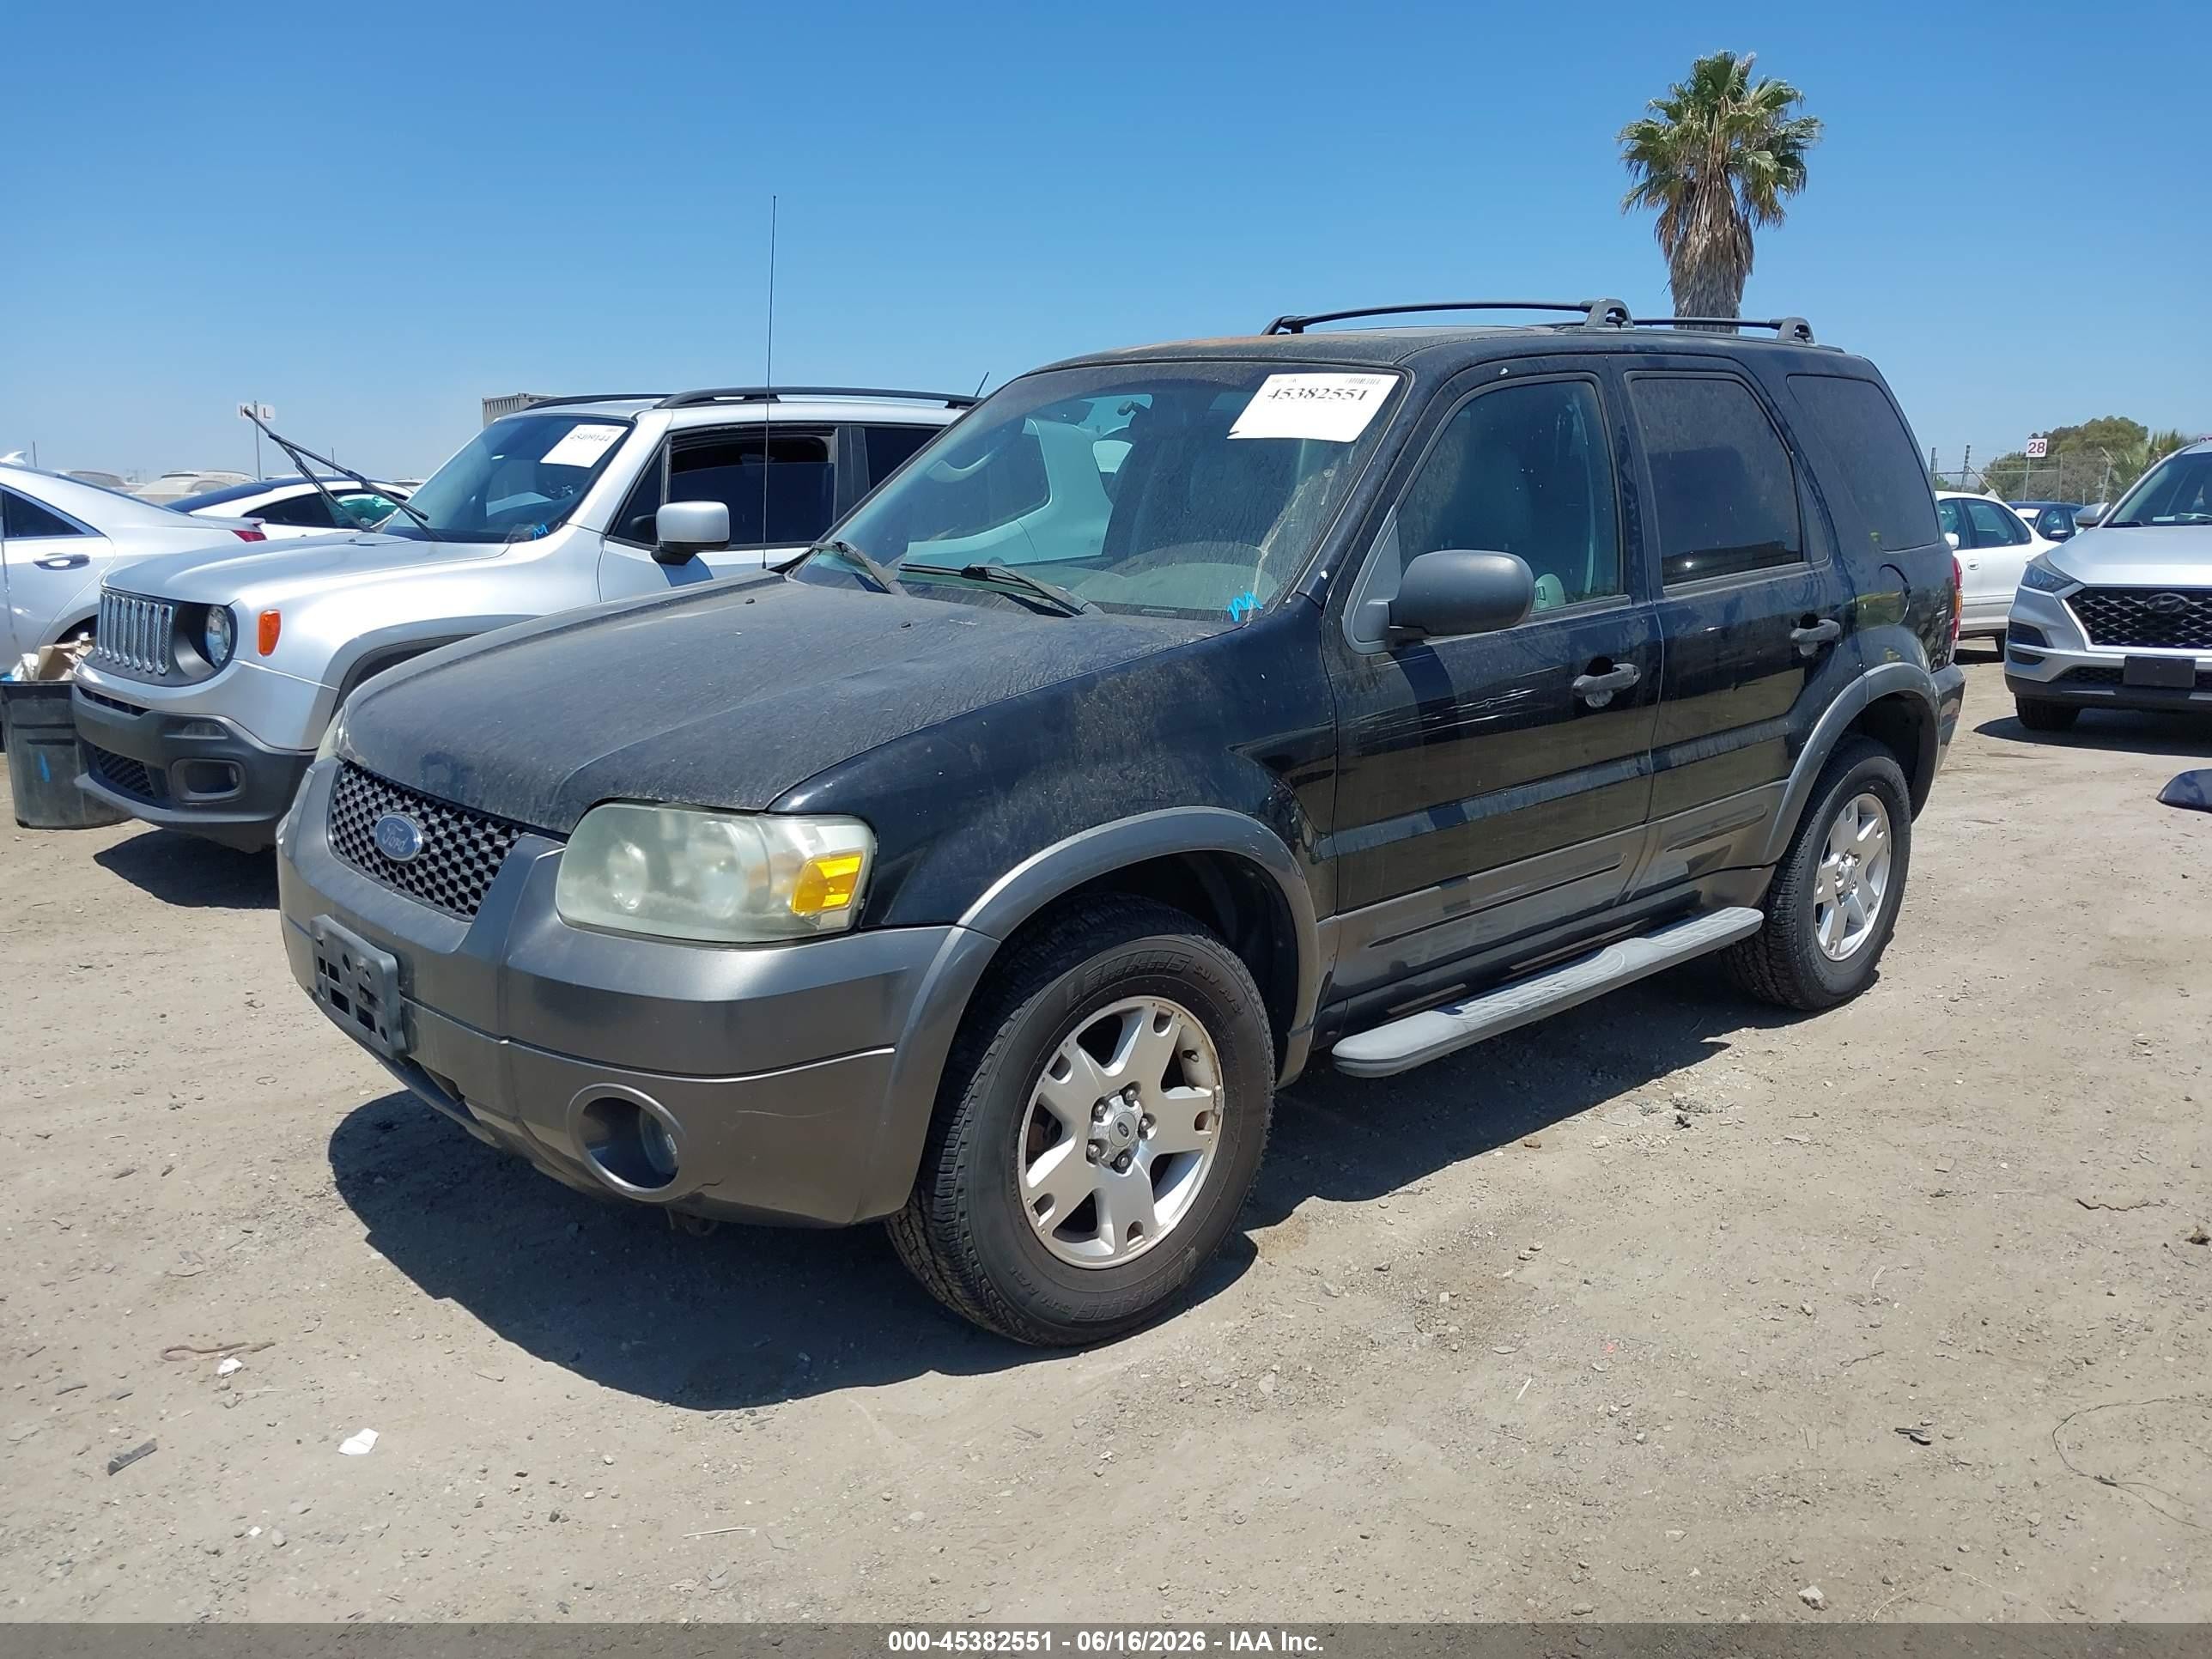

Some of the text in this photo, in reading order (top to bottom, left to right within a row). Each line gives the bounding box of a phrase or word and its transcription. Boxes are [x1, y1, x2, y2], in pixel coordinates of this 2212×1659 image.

[1267, 387, 1369, 401] 45382551
[263, 408, 271, 419] L
[2027, 441, 2045, 454] 28
[382, 823, 409, 853] Ford
